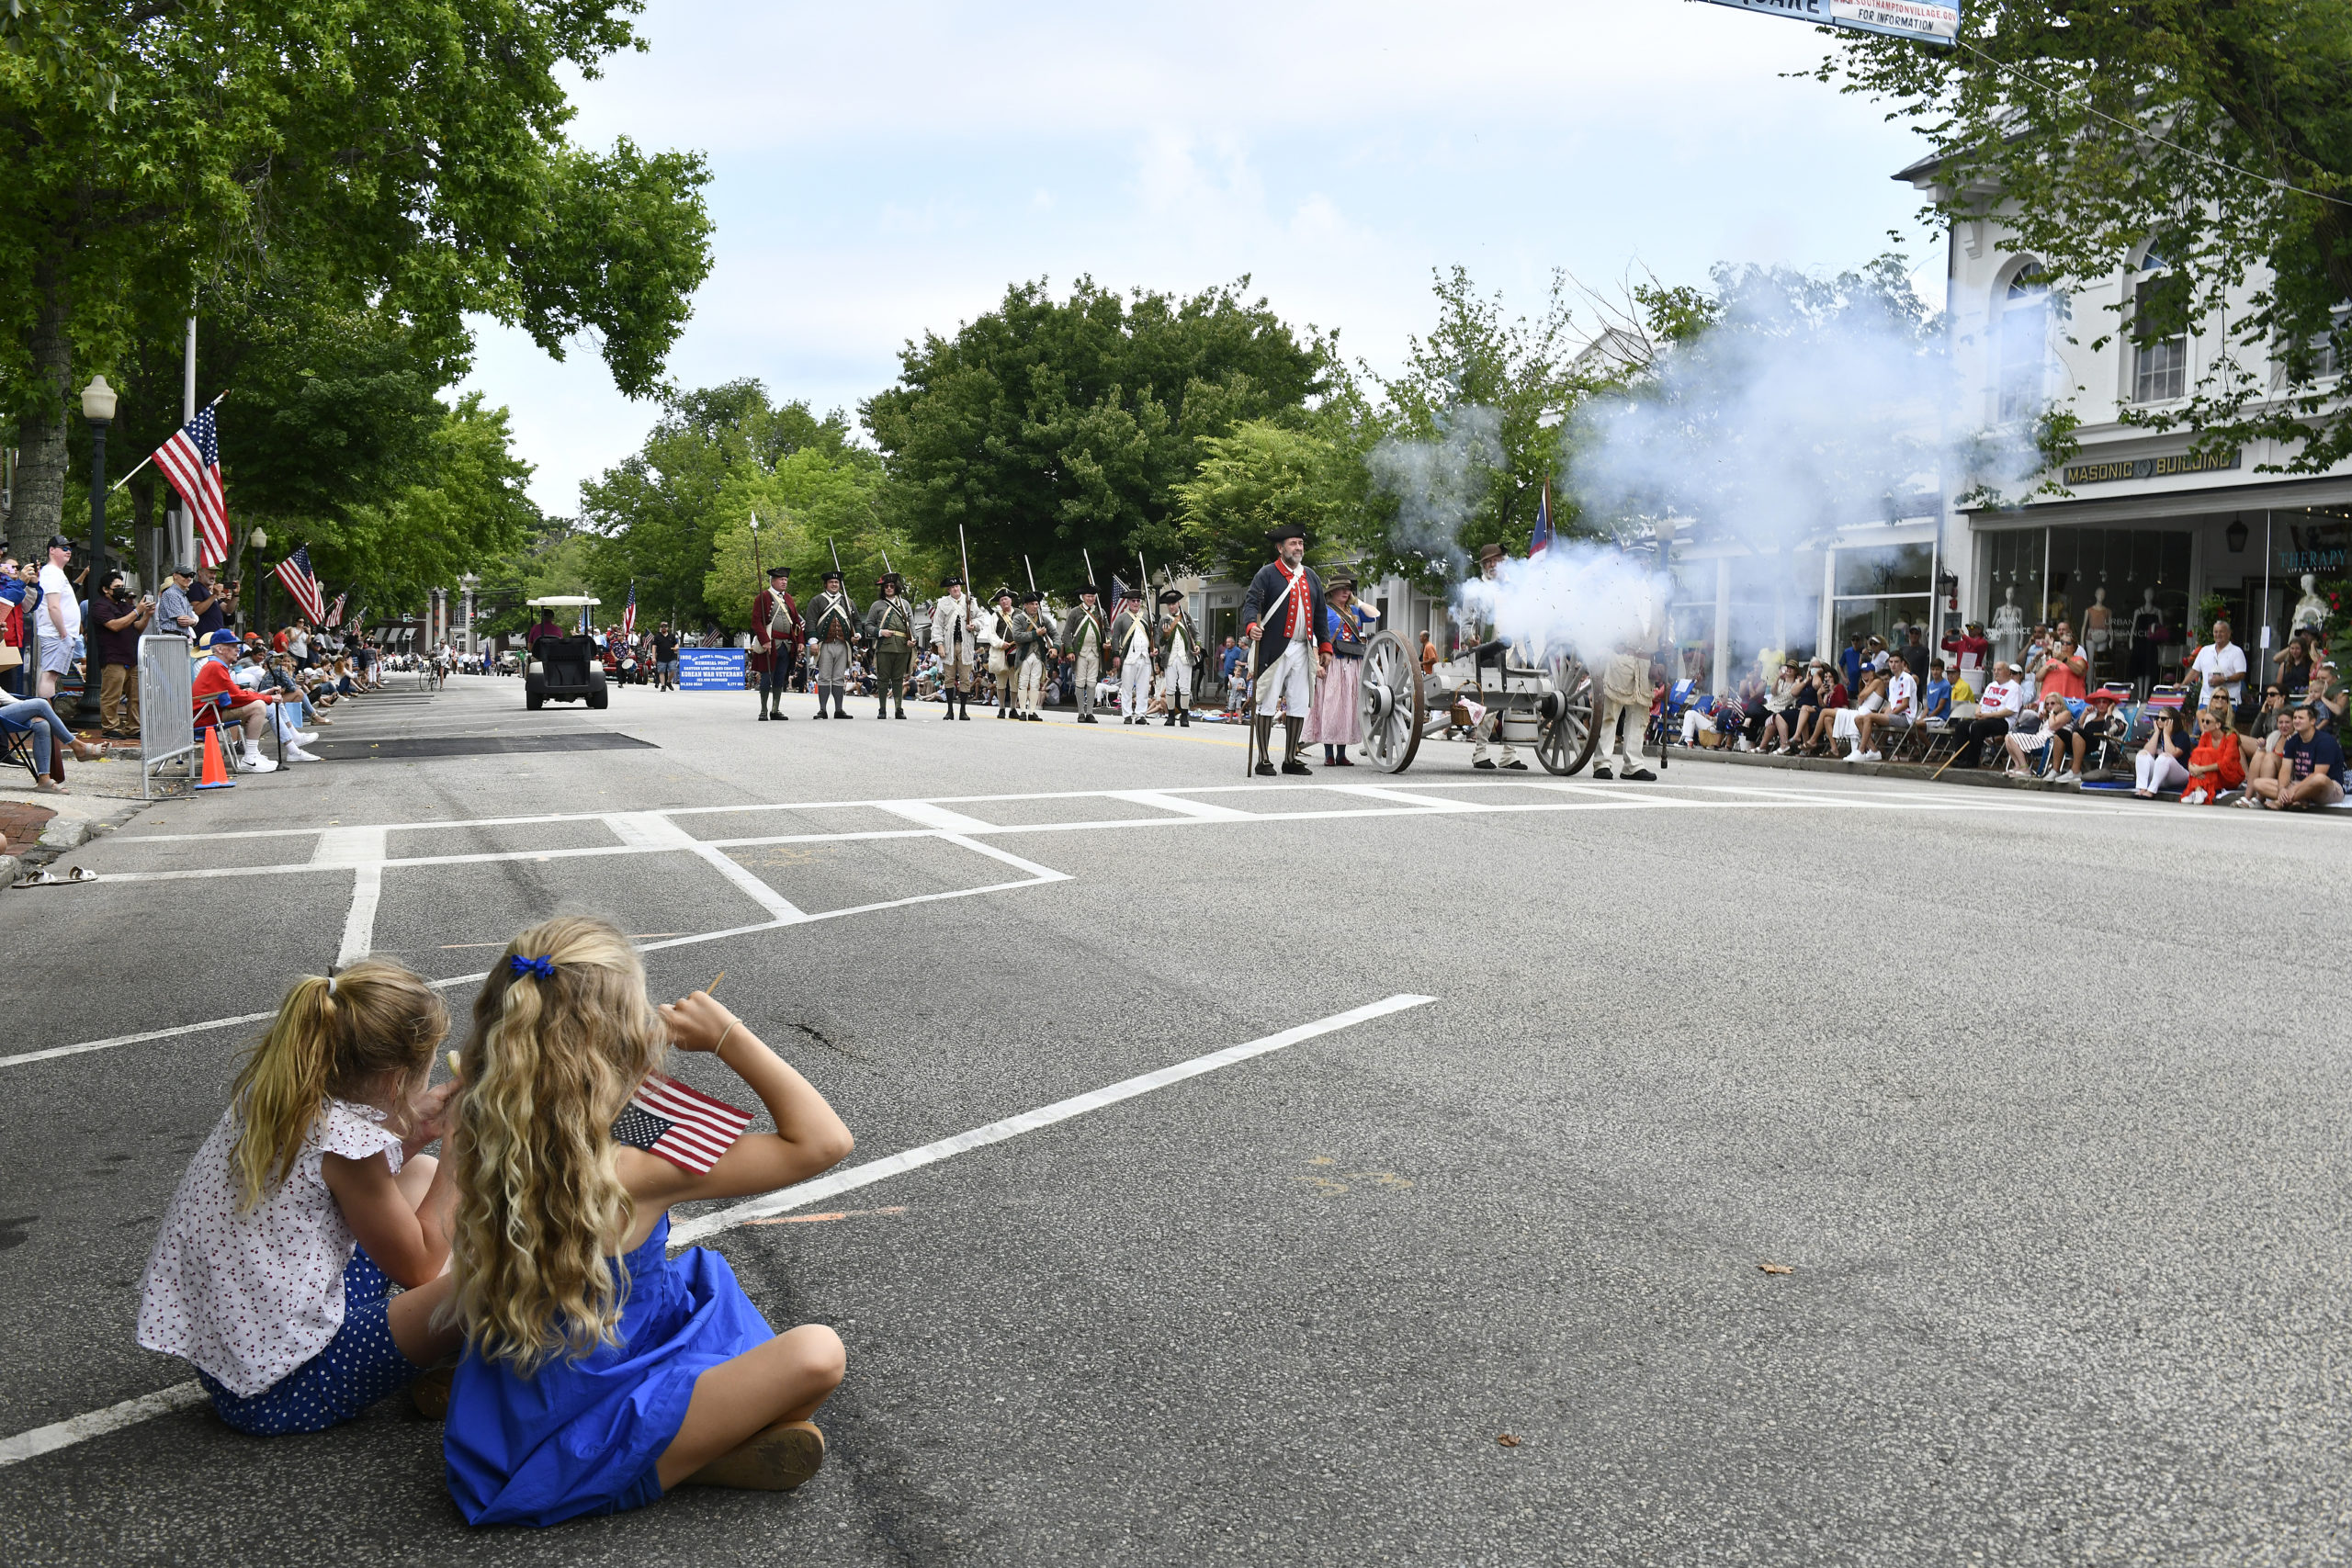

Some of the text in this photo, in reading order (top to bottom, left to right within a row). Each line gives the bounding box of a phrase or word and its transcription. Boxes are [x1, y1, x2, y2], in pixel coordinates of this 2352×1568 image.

[1834, 0, 1956, 21] W.SOUTHAMPTONVILLAGE.GOV
[1859, 8, 1934, 31] FOR INFORMATION
[2068, 461, 2133, 483] MASONIC
[2278, 548, 2347, 568] THERAPY
